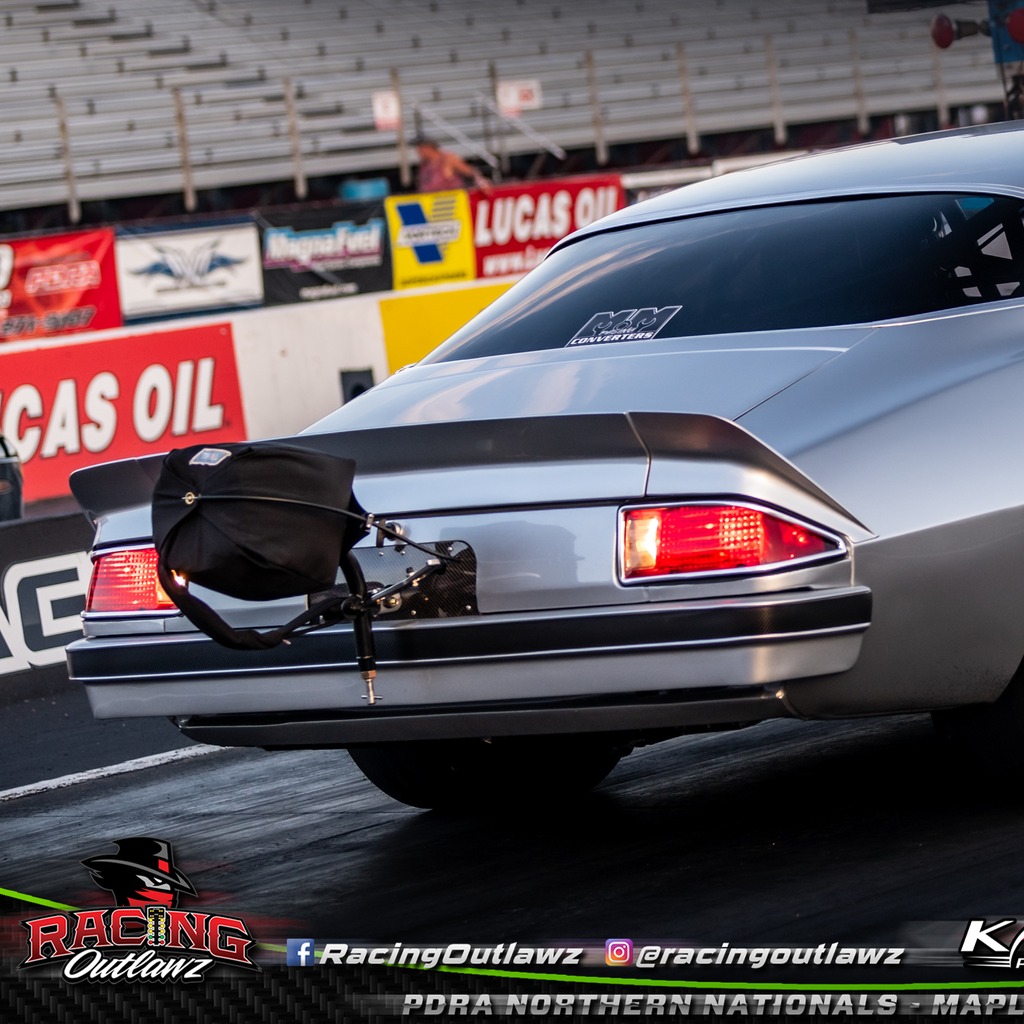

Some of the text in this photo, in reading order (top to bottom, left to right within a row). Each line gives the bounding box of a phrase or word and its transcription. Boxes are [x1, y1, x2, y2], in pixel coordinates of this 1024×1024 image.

[475, 189, 572, 247] LUCAS
[570, 332, 654, 345] CONVERTERS
[133, 356, 225, 443] OIL
